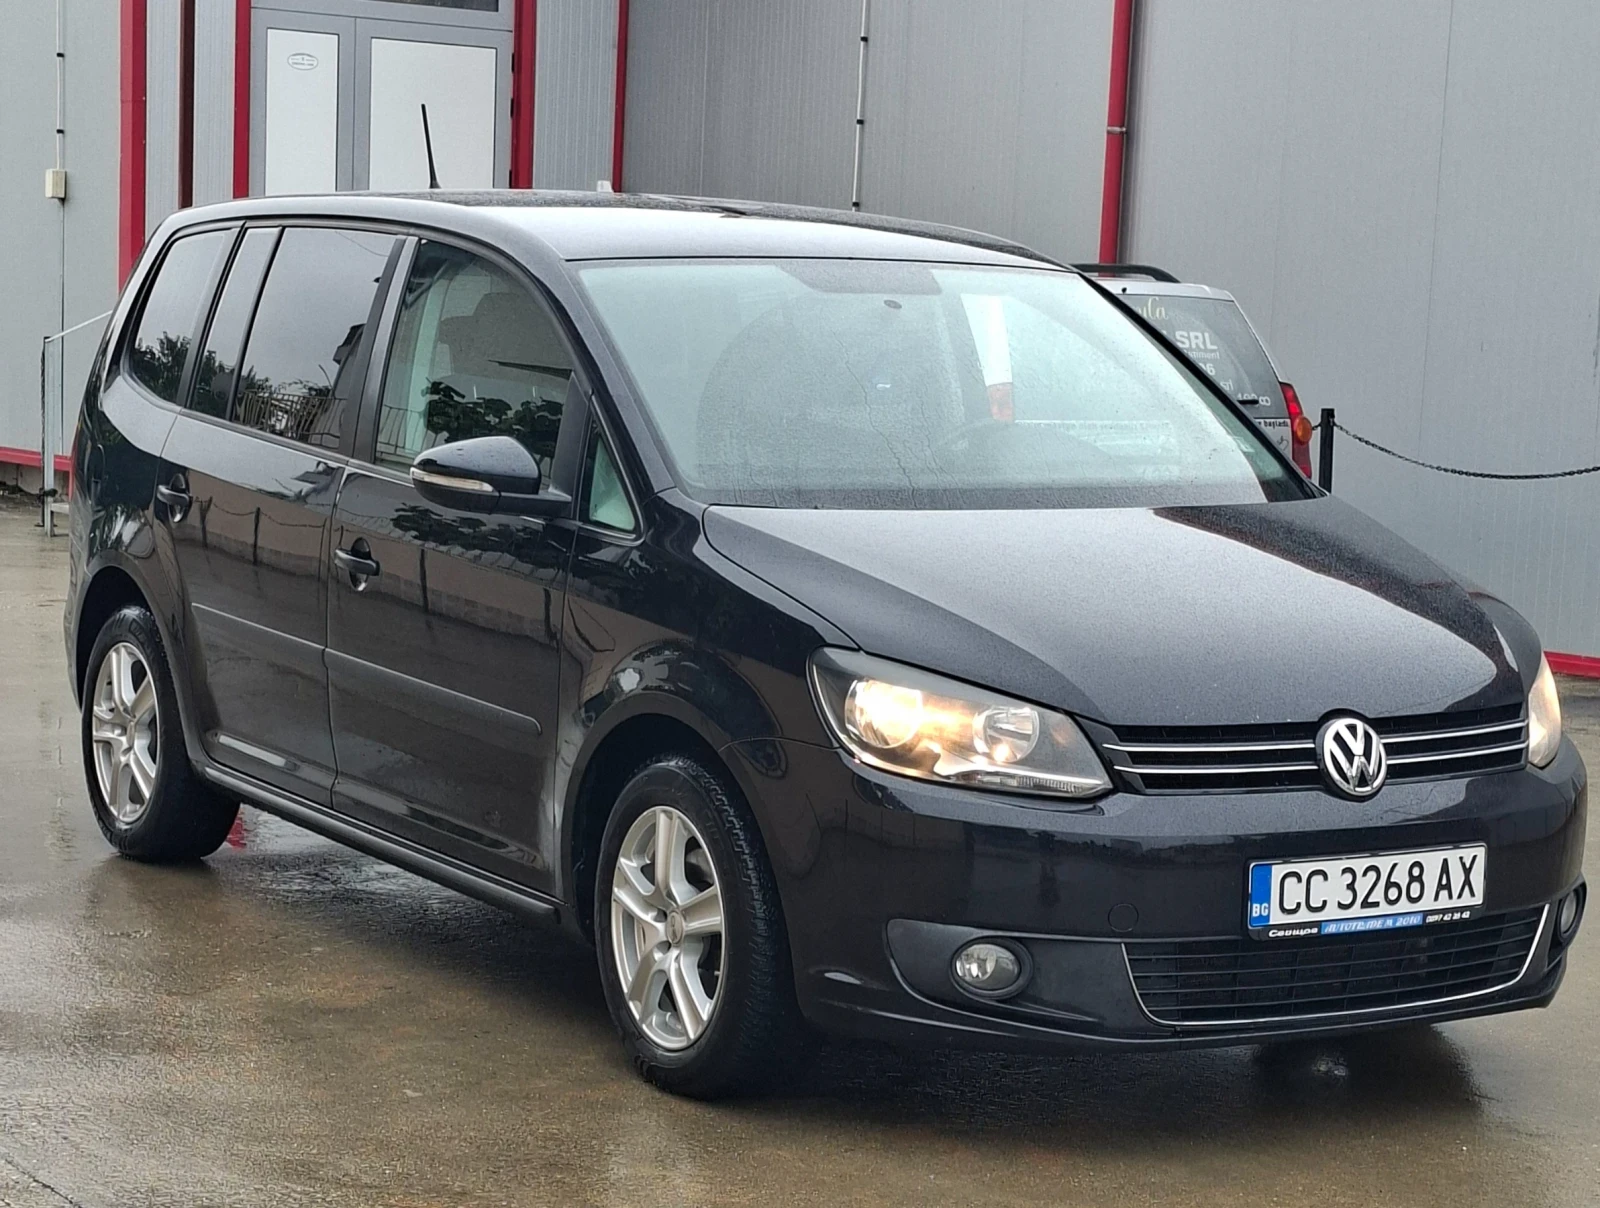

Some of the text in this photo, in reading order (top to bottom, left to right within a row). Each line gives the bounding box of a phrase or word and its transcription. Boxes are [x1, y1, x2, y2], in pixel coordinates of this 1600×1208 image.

[1175, 331, 1218, 350] SRL
[1279, 854, 1478, 914] CC 3268 AX
[1252, 903, 1269, 917] BG
